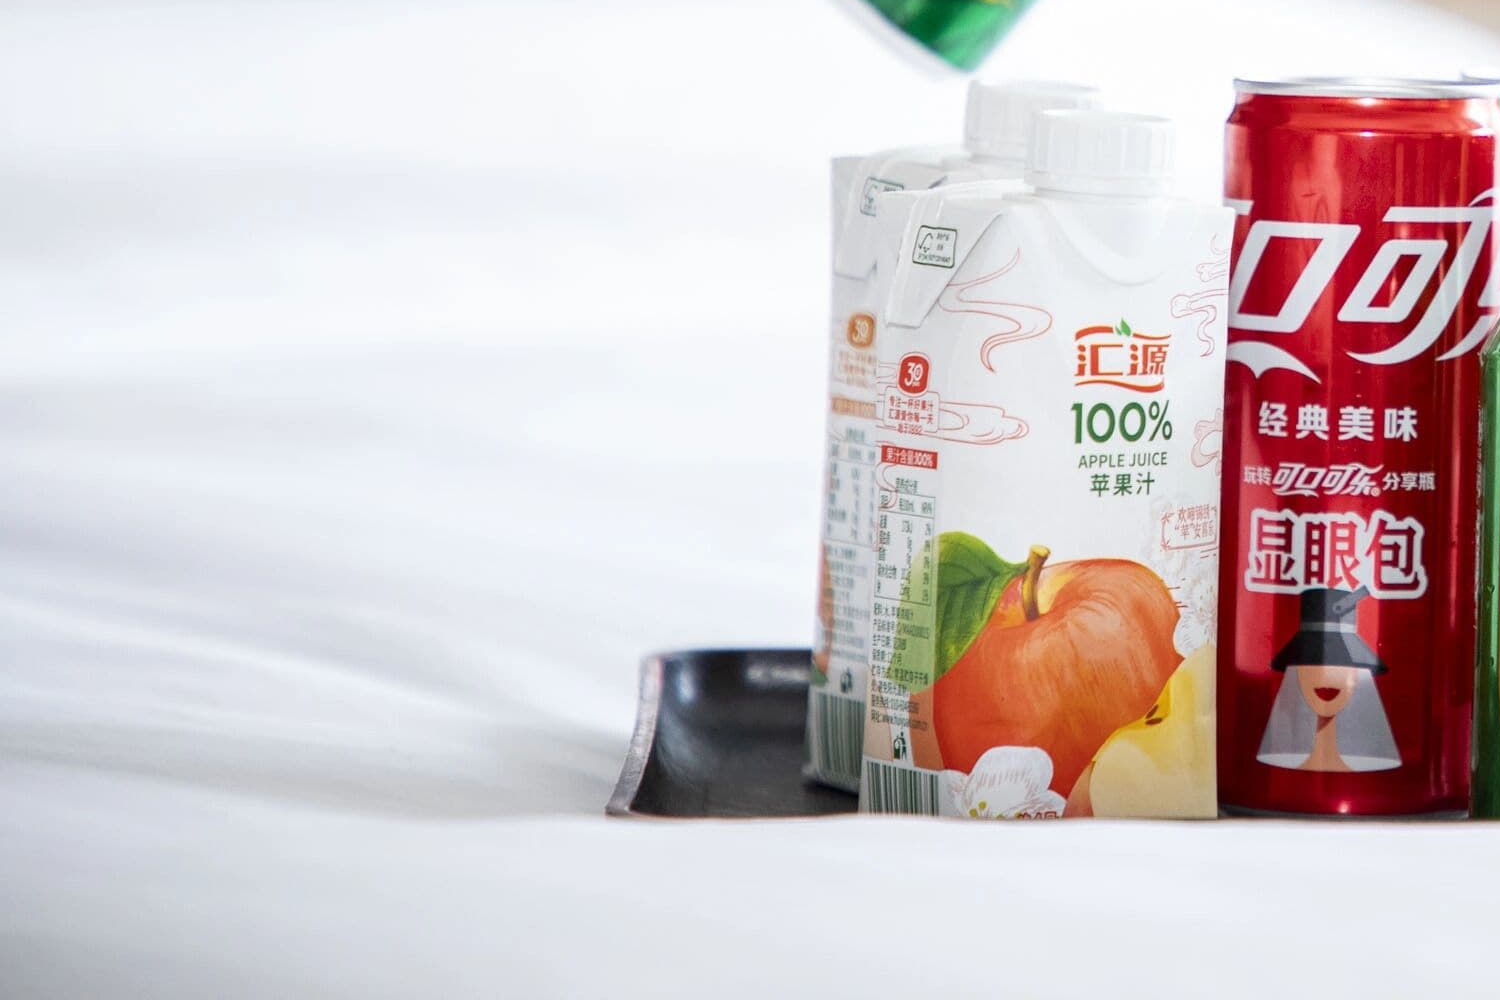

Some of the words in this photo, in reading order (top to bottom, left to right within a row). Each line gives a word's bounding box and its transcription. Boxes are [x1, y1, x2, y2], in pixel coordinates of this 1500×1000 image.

[1074, 342, 1170, 377] 汇源
[1071, 400, 1173, 444] 100%
[1257, 400, 1418, 442] 经典美味
[1078, 454, 1125, 469] APPLE
[1128, 451, 1168, 467] JUICE
[1089, 471, 1156, 497] 苹果汁
[1245, 508, 1428, 600] 显眼包
